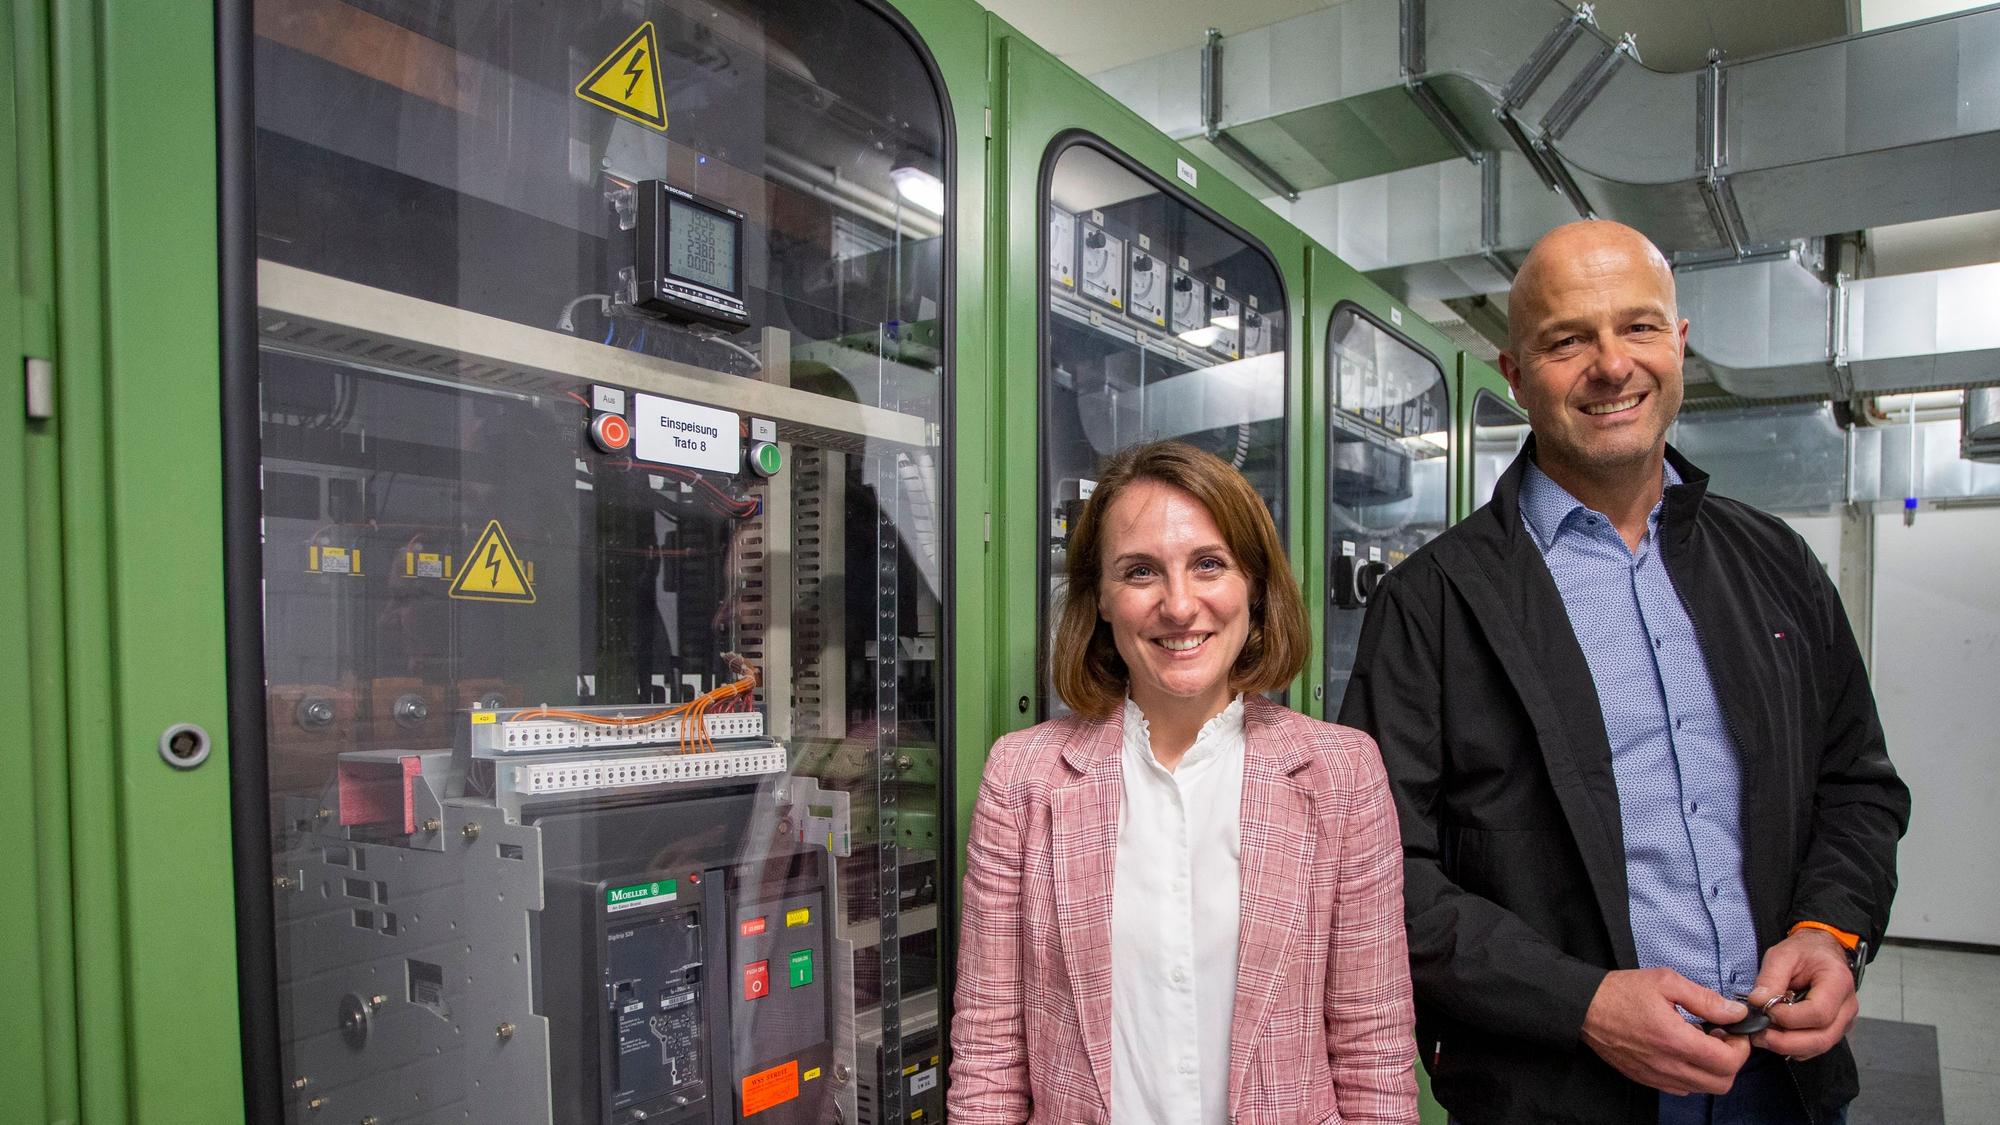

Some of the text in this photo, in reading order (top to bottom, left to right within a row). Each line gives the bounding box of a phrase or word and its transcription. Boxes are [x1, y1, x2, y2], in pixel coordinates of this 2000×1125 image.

[602, 393, 616, 405] Aus
[660, 415, 718, 439] Einspeisung
[672, 435, 697, 451] Trafo
[700, 440, 707, 452] 8
[611, 888, 648, 902] MOELLER
